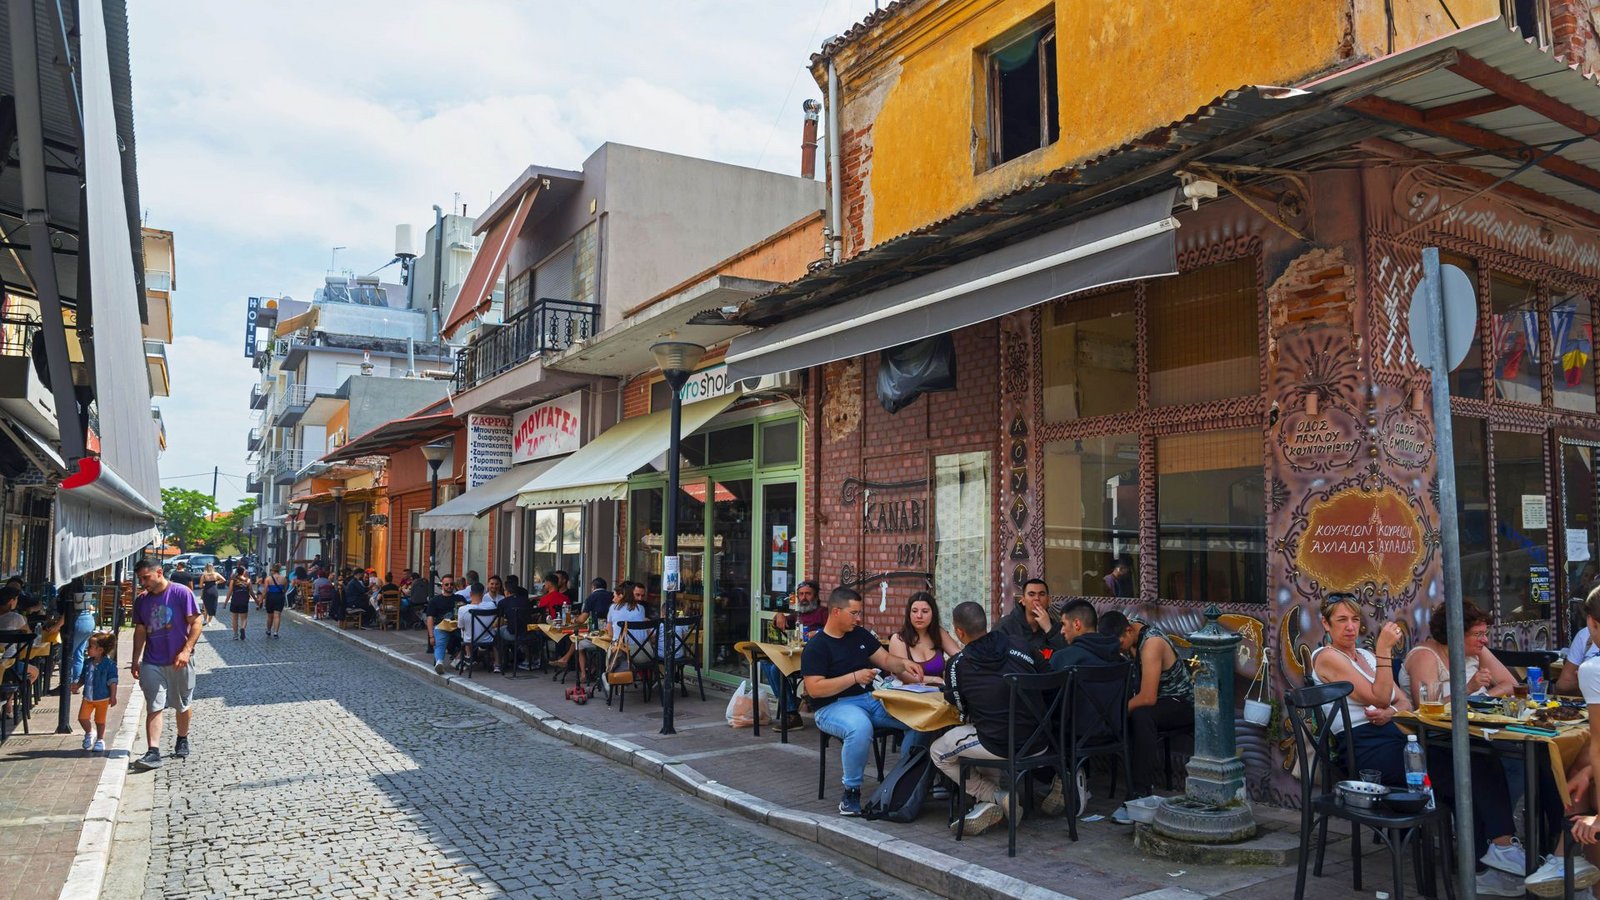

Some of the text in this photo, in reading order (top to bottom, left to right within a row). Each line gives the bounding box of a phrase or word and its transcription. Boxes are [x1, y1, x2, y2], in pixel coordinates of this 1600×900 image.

[247, 299, 258, 356] HOTEL
[1297, 420, 1329, 432] ΟΔΟΣ
[1395, 422, 1415, 436] ΟΔΟΣ
[1296, 431, 1340, 444] ΠΑΥΛΟΥ
[1389, 436, 1425, 454] ΕΜΠΟΡΙΟΥ
[1013, 419, 1024, 590] ΚΟΥΡΕΙ
